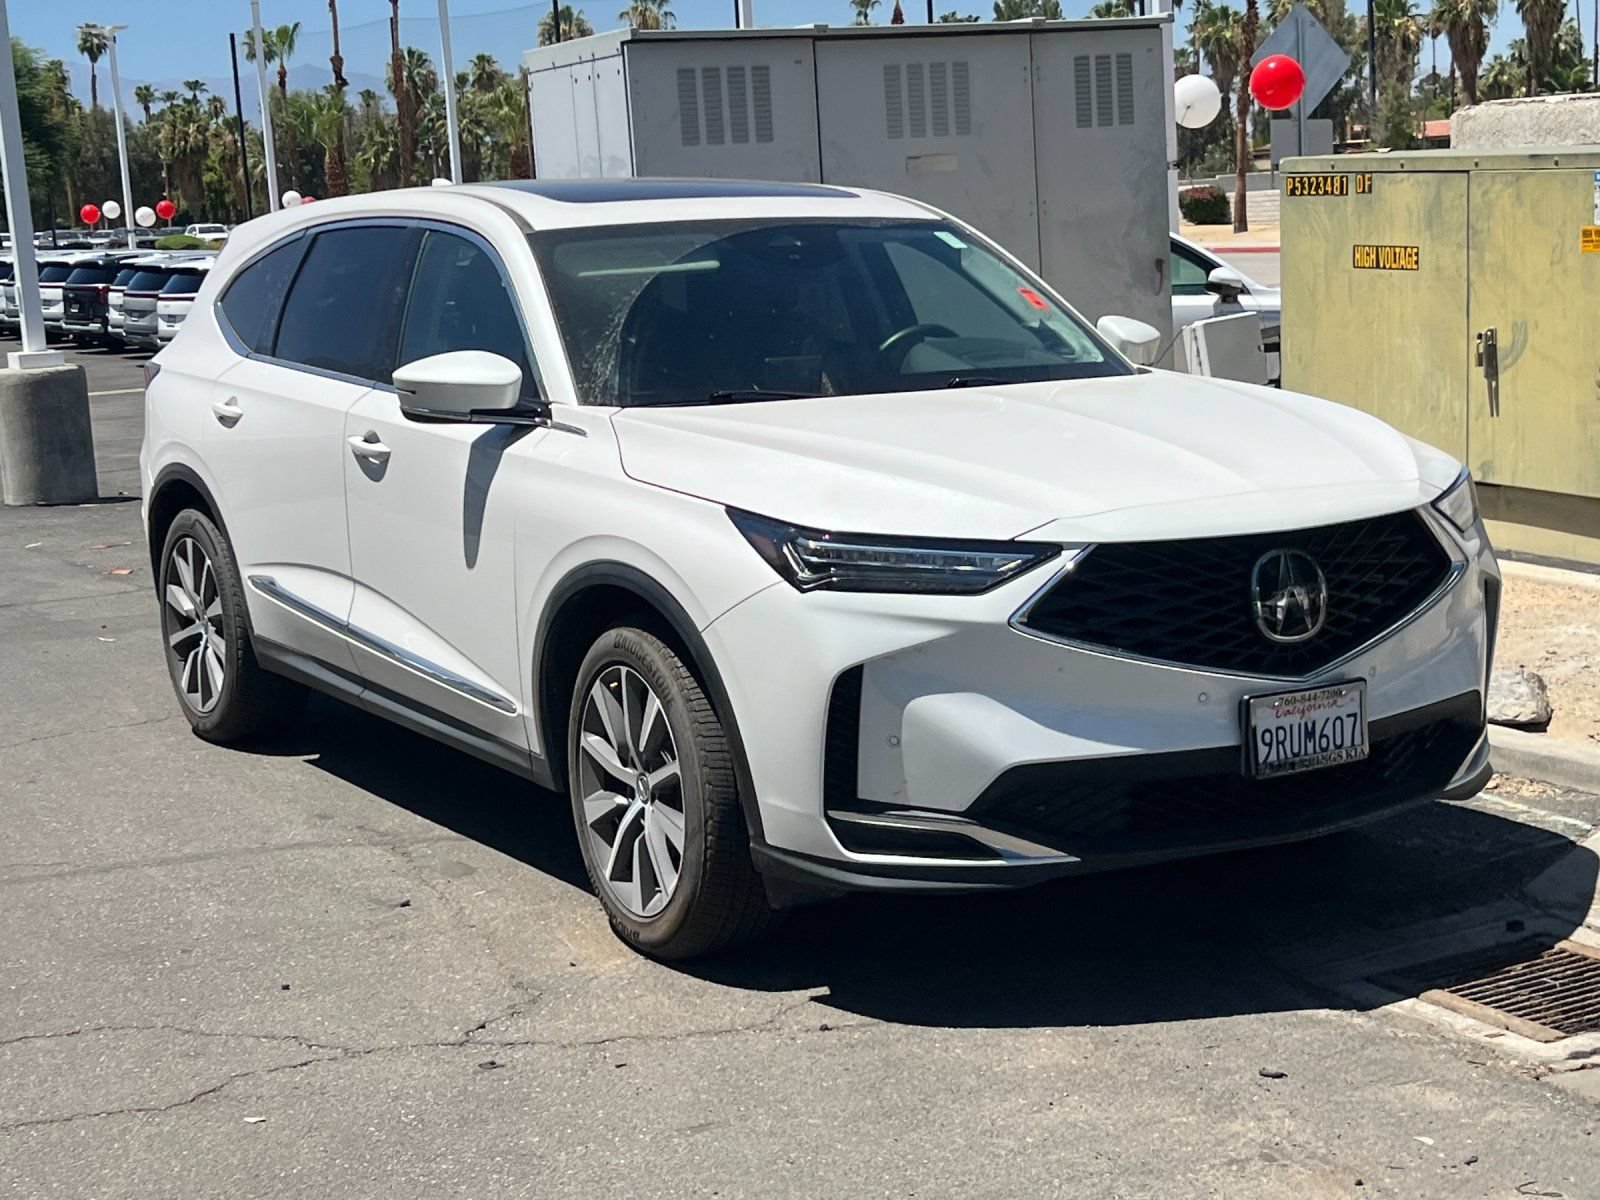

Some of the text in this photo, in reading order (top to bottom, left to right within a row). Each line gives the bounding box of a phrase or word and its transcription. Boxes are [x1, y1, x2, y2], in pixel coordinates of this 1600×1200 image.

[1287, 176, 1347, 196] P5323481
[1354, 246, 1418, 269] HIGH VOLTAGE
[1261, 712, 1358, 764] 9RUM607
